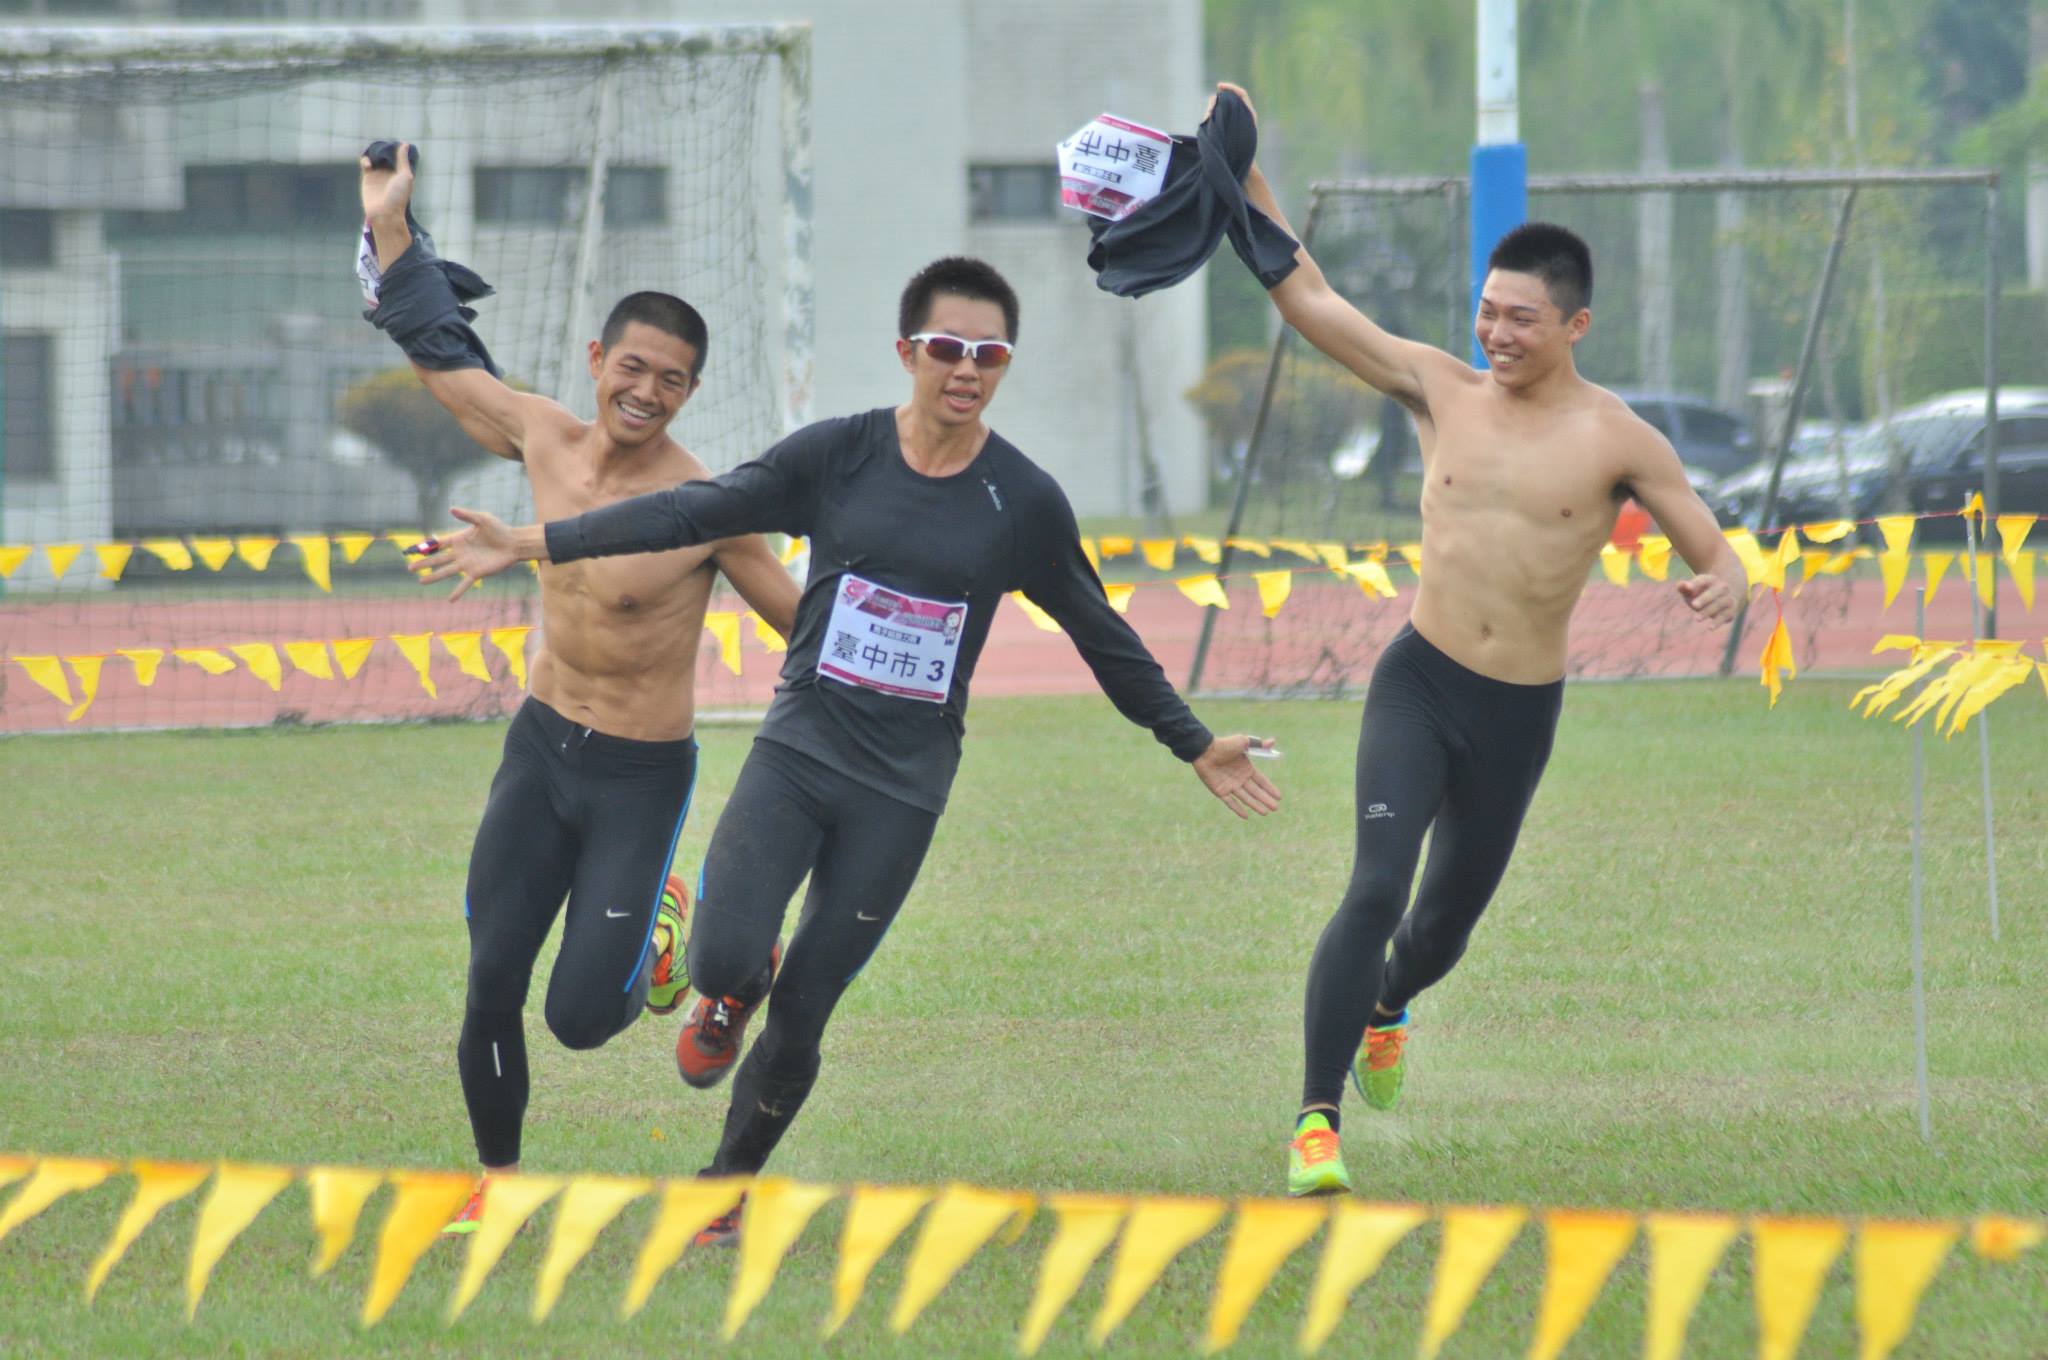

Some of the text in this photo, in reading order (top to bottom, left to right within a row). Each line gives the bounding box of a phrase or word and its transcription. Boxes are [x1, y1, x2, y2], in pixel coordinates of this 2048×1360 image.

[832, 629, 921, 679] 臺中市
[926, 659, 946, 682] 3
